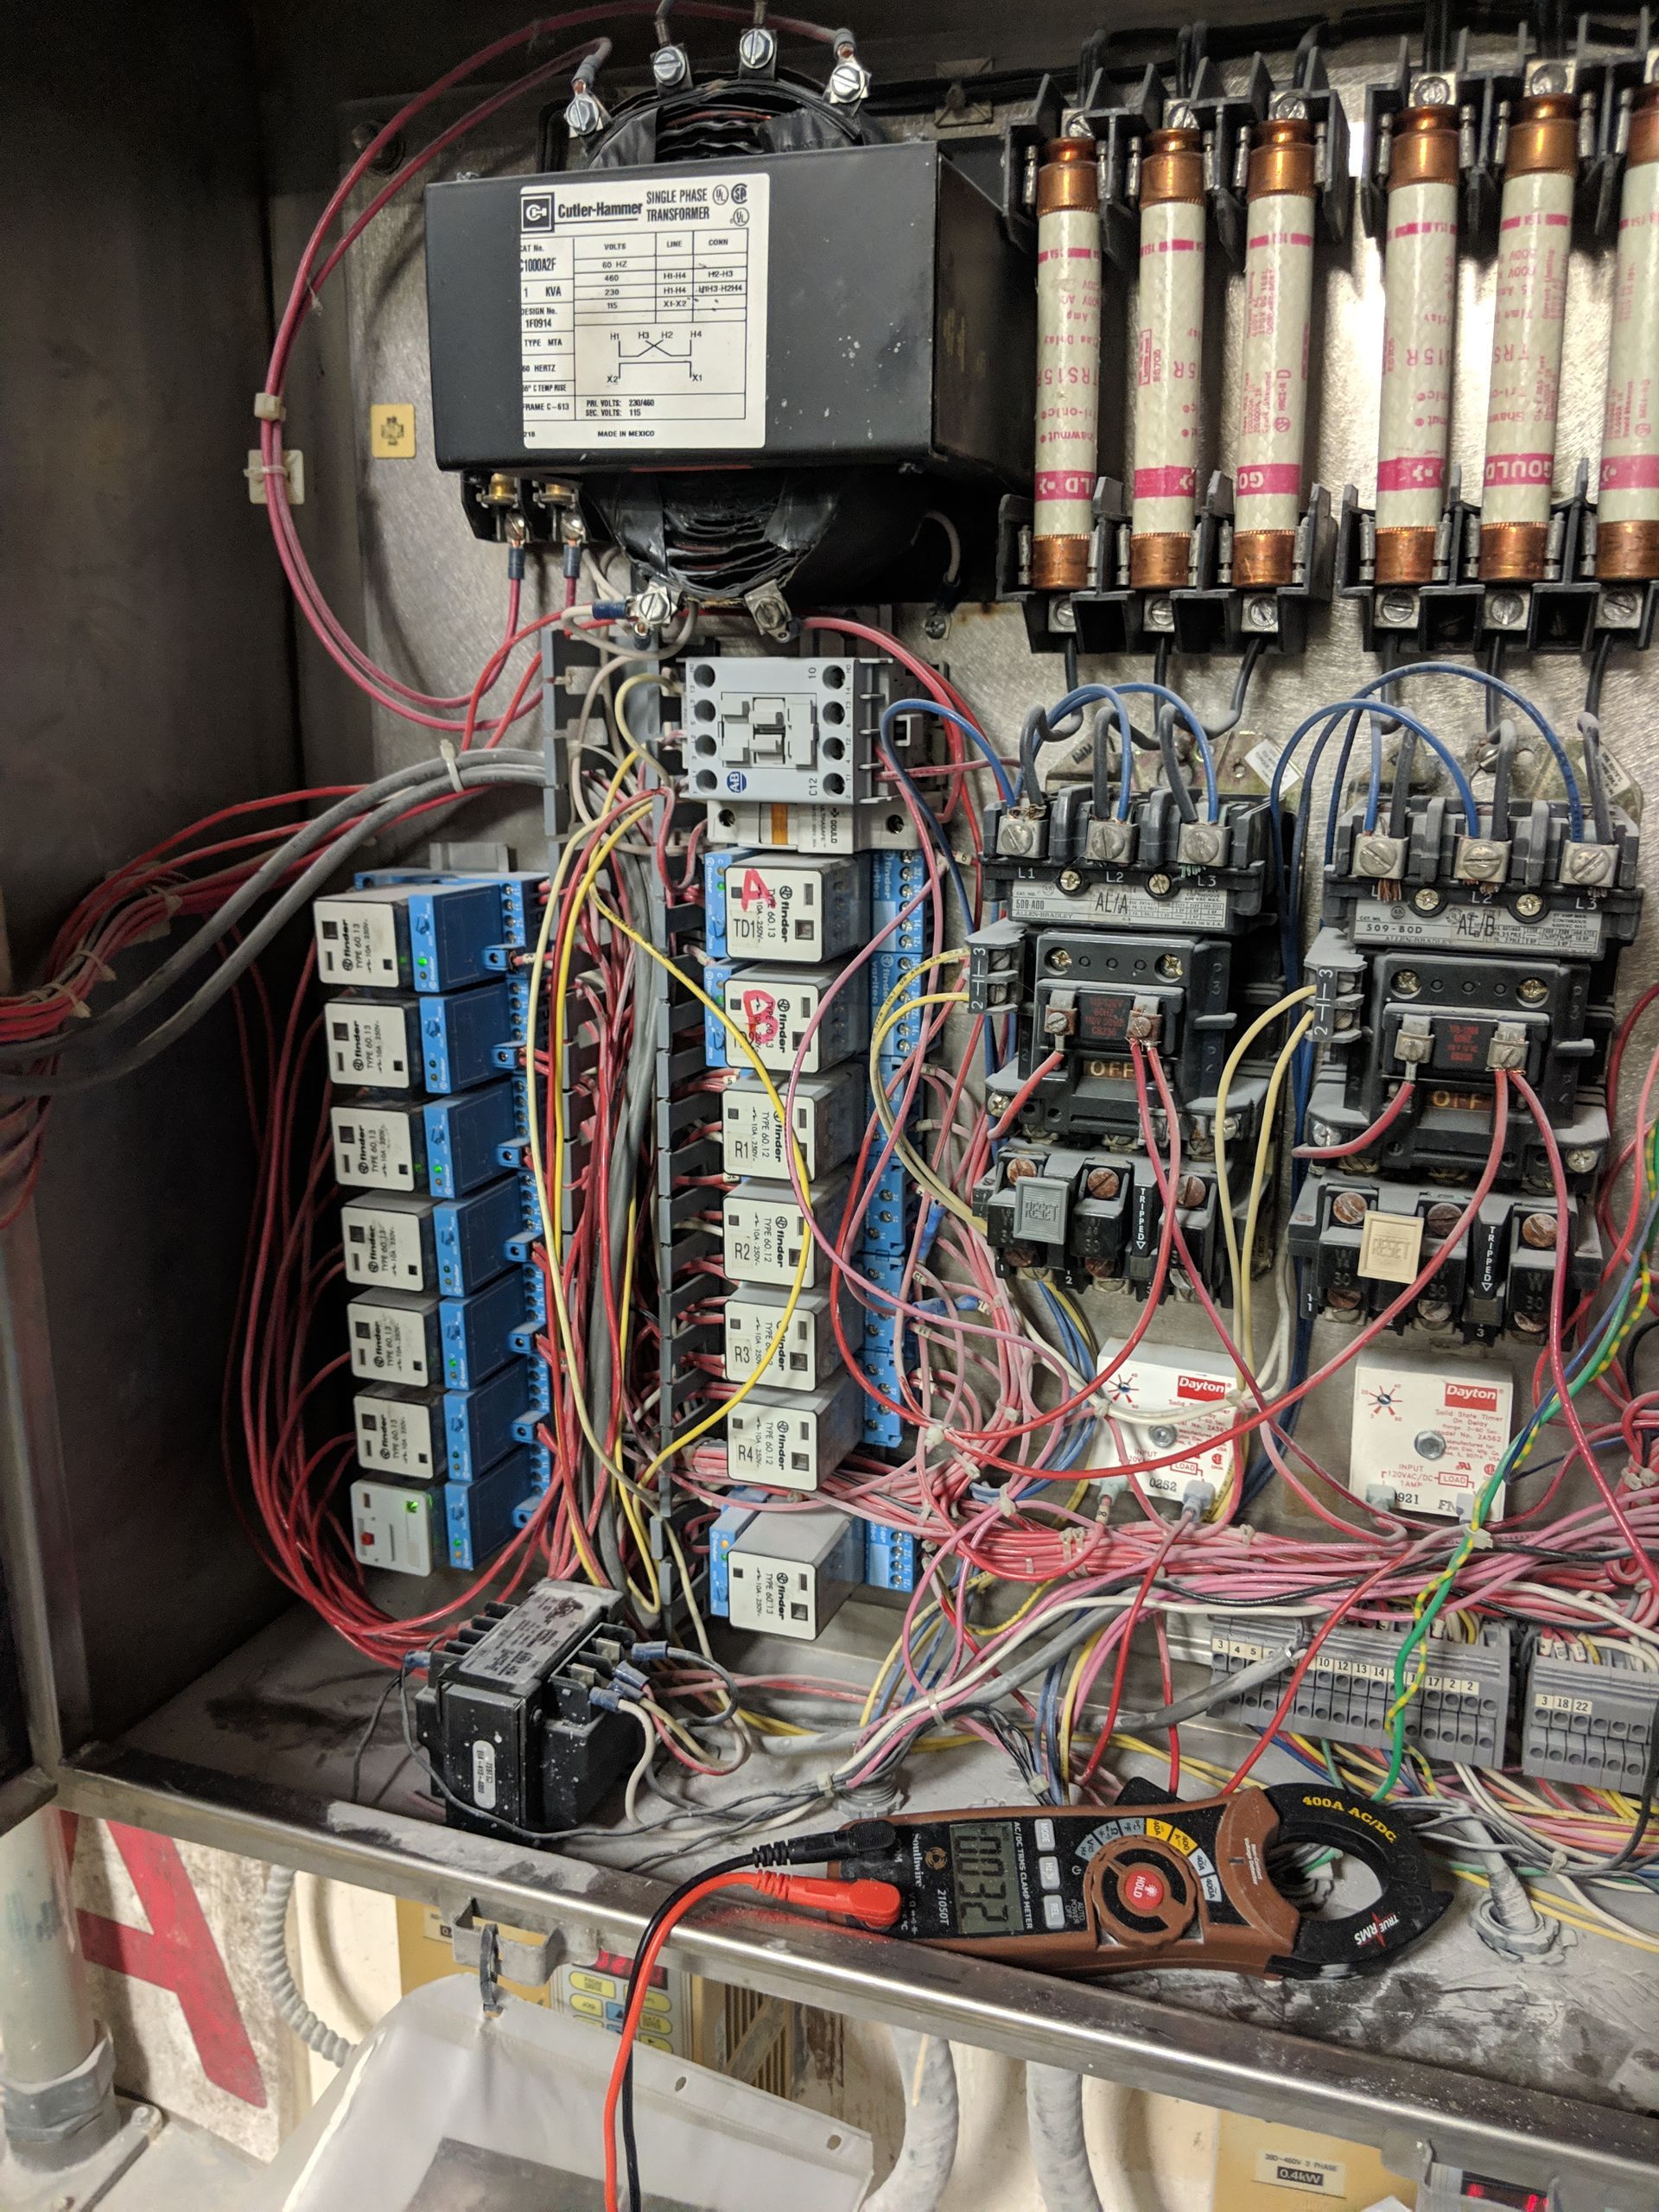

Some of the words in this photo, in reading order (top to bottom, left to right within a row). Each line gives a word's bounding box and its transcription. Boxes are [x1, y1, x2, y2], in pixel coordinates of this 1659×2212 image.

[647, 190, 676, 205] SINGLE
[679, 188, 708, 202] PHASE
[558, 201, 643, 219] Cutler-Hammer
[646, 207, 710, 222] TRANSFORMER
[546, 287, 562, 296] KVA
[525, 319, 552, 328] 1F0914
[1485, 461, 1553, 477] GOULD
[809, 779, 817, 797] C12
[1018, 868, 1035, 880] L1
[1106, 871, 1124, 883] L2
[1198, 875, 1217, 887] L3
[741, 868, 777, 912] A
[1471, 891, 1491, 904] L2
[1576, 897, 1597, 909] L3
[734, 918, 755, 938] TD1
[767, 911, 776, 938] 60.13
[779, 899, 788, 943] finder
[343, 919, 352, 957] finder
[353, 1020, 362, 1058] finder
[1090, 1061, 1135, 1077] OFF
[761, 1112, 770, 1131] TYPE
[359, 1125, 369, 1162] finder
[734, 1141, 749, 1159] R1
[761, 1133, 770, 1158] 60.12
[1138, 1187, 1147, 1242] TRIPPED
[369, 1224, 378, 1261] finder
[734, 1243, 750, 1260] R2
[763, 1236, 772, 1262] 60.12
[777, 1230, 785, 1268] finder
[1484, 1225, 1495, 1281] TRIPPED
[734, 1345, 750, 1363] R3
[1179, 1377, 1225, 1394] Dayton
[1446, 1385, 1497, 1402] Dayton
[1468, 1419, 1488, 1427] Delay
[739, 1445, 753, 1462] R4
[1135, 1448, 1157, 1458] INPUT
[1175, 1462, 1197, 1471] LOAD
[1399, 1464, 1423, 1472] INPUT
[1150, 1477, 1177, 1492] 0252
[1388, 1472, 1433, 1482] 120VAC/DC
[1444, 1475, 1465, 1484] LOAD
[776, 1583, 785, 1620] finder
[1218, 1640, 1224, 1649] 3
[1234, 1645, 1240, 1654] 4
[1250, 1648, 1256, 1656] 5
[1319, 1658, 1330, 1668] 10
[1338, 1662, 1348, 1670] 12
[1356, 1664, 1367, 1674] 13
[1374, 1667, 1384, 1677] 14
[1428, 1677, 1440, 1687] 17
[1450, 1679, 1455, 1688] 2
[1467, 1682, 1472, 1691] 2
[1541, 1696, 1548, 1706] 3
[1558, 1699, 1569, 1708] 18
[1576, 1701, 1588, 1711] 22
[1303, 1796, 1344, 1812] 400A
[1349, 1807, 1396, 1843] AC/DC
[1014, 1821, 1023, 1847] AC/DC
[1041, 1822, 1051, 1843] MODE
[912, 1833, 923, 1888] Southwire
[1017, 1849, 1027, 1871] TRMS
[1020, 1872, 1029, 1899] CLAMP
[1134, 1876, 1145, 1898] HOLD
[938, 1890, 950, 1926] 21050T
[1023, 1901, 1033, 1929] METER
[1050, 1903, 1059, 1917] REL
[1381, 1914, 1399, 1933] TRUE
[1354, 1923, 1378, 1945] RMS
[1314, 2162, 1337, 2171] PHASE
[1281, 2169, 1321, 2184] 0.4kW
